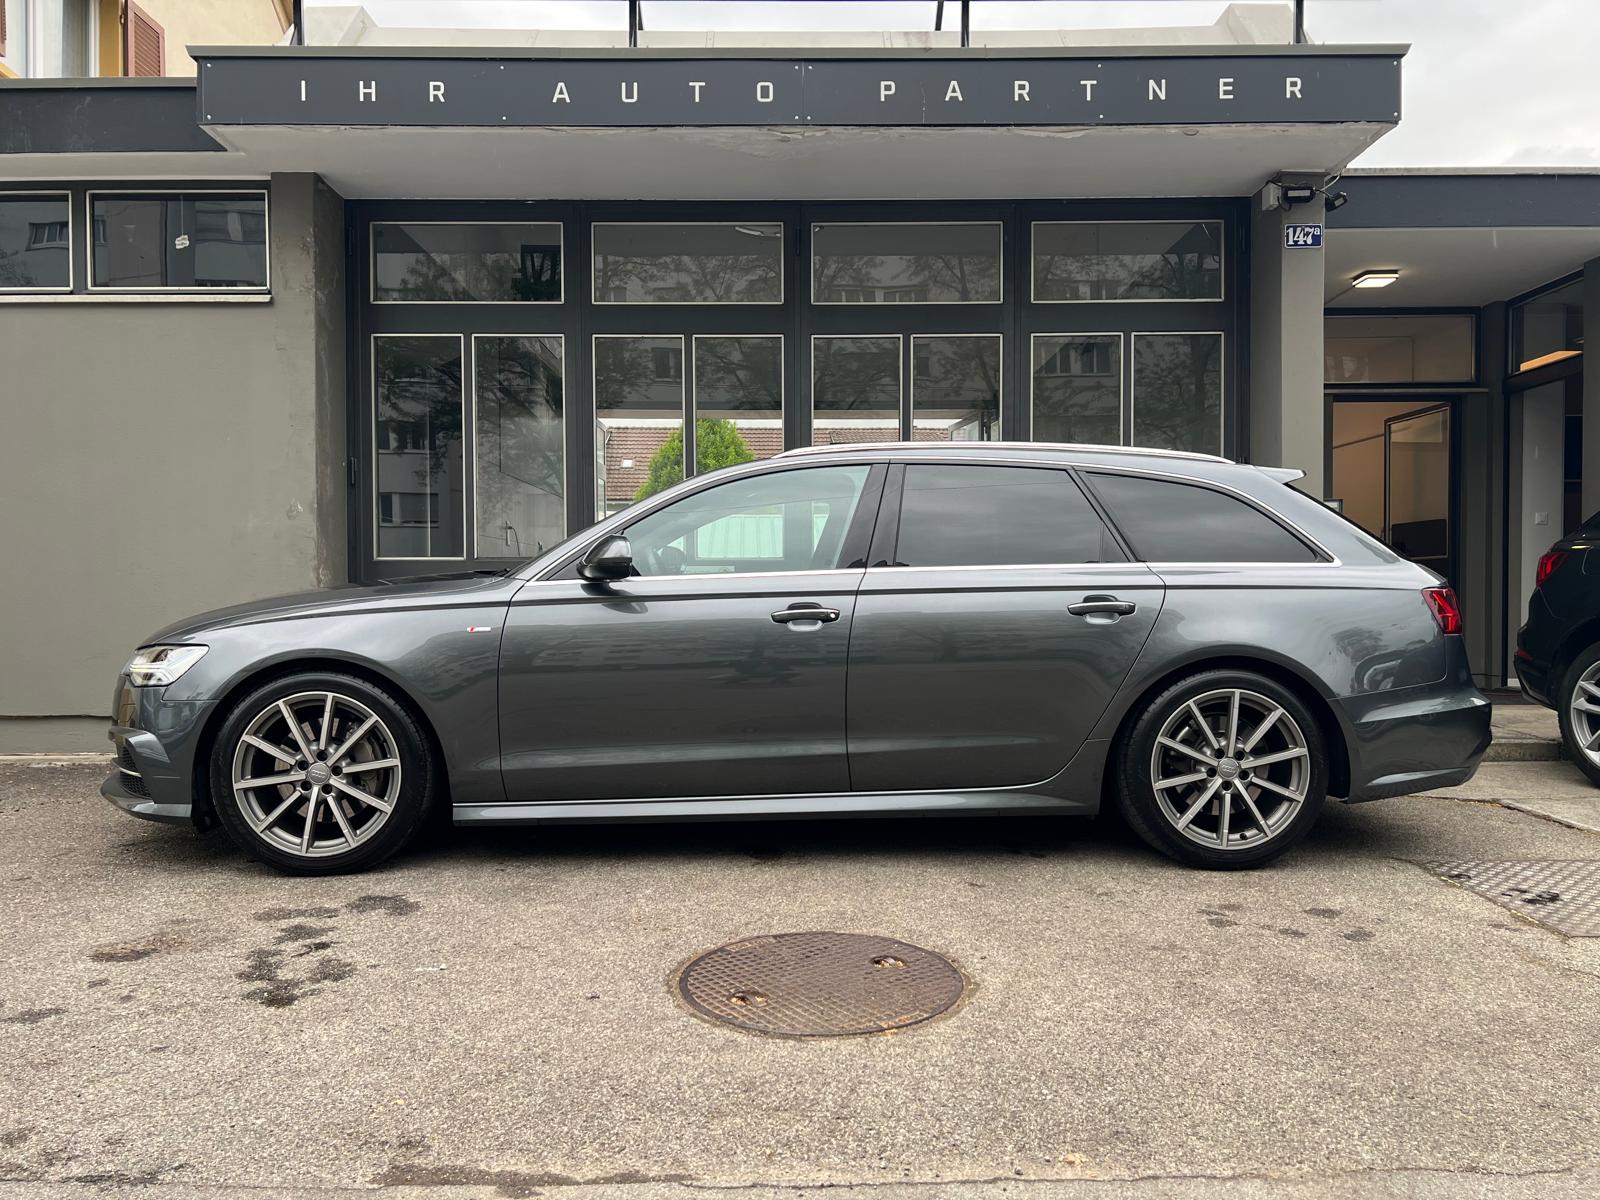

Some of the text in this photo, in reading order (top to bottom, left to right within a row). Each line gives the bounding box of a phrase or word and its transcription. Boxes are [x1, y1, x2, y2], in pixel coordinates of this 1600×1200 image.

[300, 77, 1303, 104] IHR AUTO PARTNER
[1286, 226, 1321, 245] 147a
